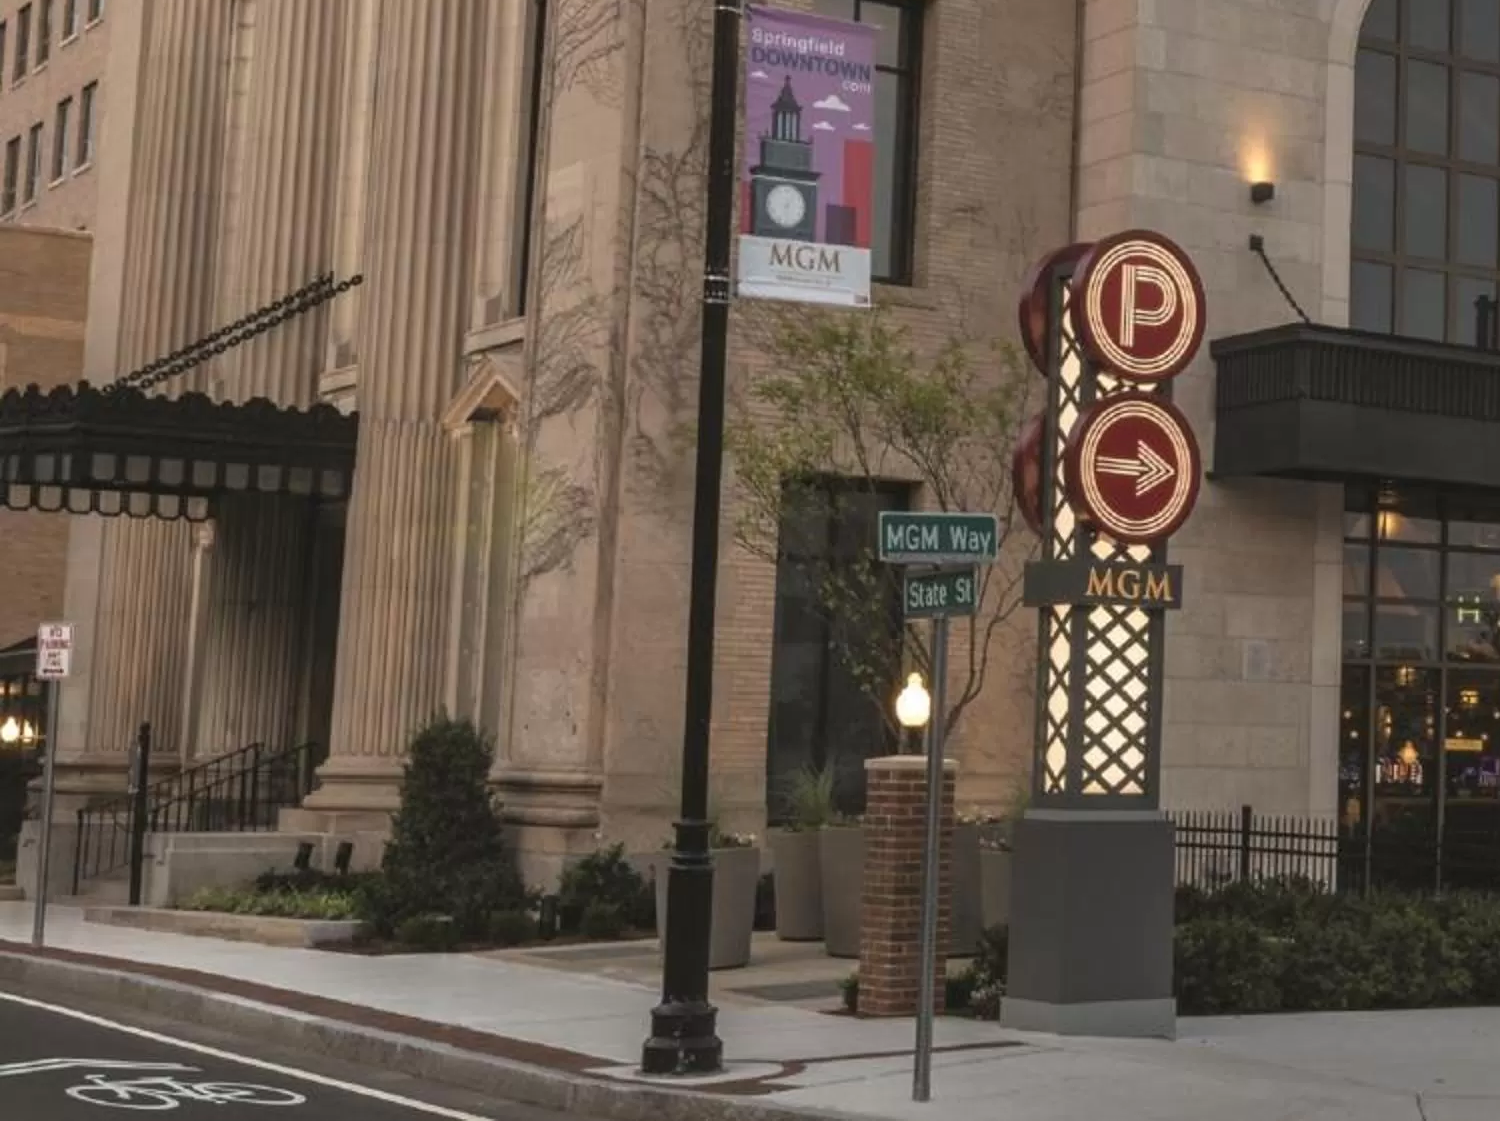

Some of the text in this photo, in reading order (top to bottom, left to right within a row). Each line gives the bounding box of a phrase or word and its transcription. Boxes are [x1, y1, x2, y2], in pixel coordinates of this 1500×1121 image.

[752, 27, 844, 55] Springfield
[752, 47, 871, 81] DOWNTOWN
[768, 243, 841, 273] MGM
[1120, 263, 1177, 347] P
[887, 524, 992, 556] MGM Way
[909, 578, 972, 608] State St
[1085, 567, 1174, 601] MGM
